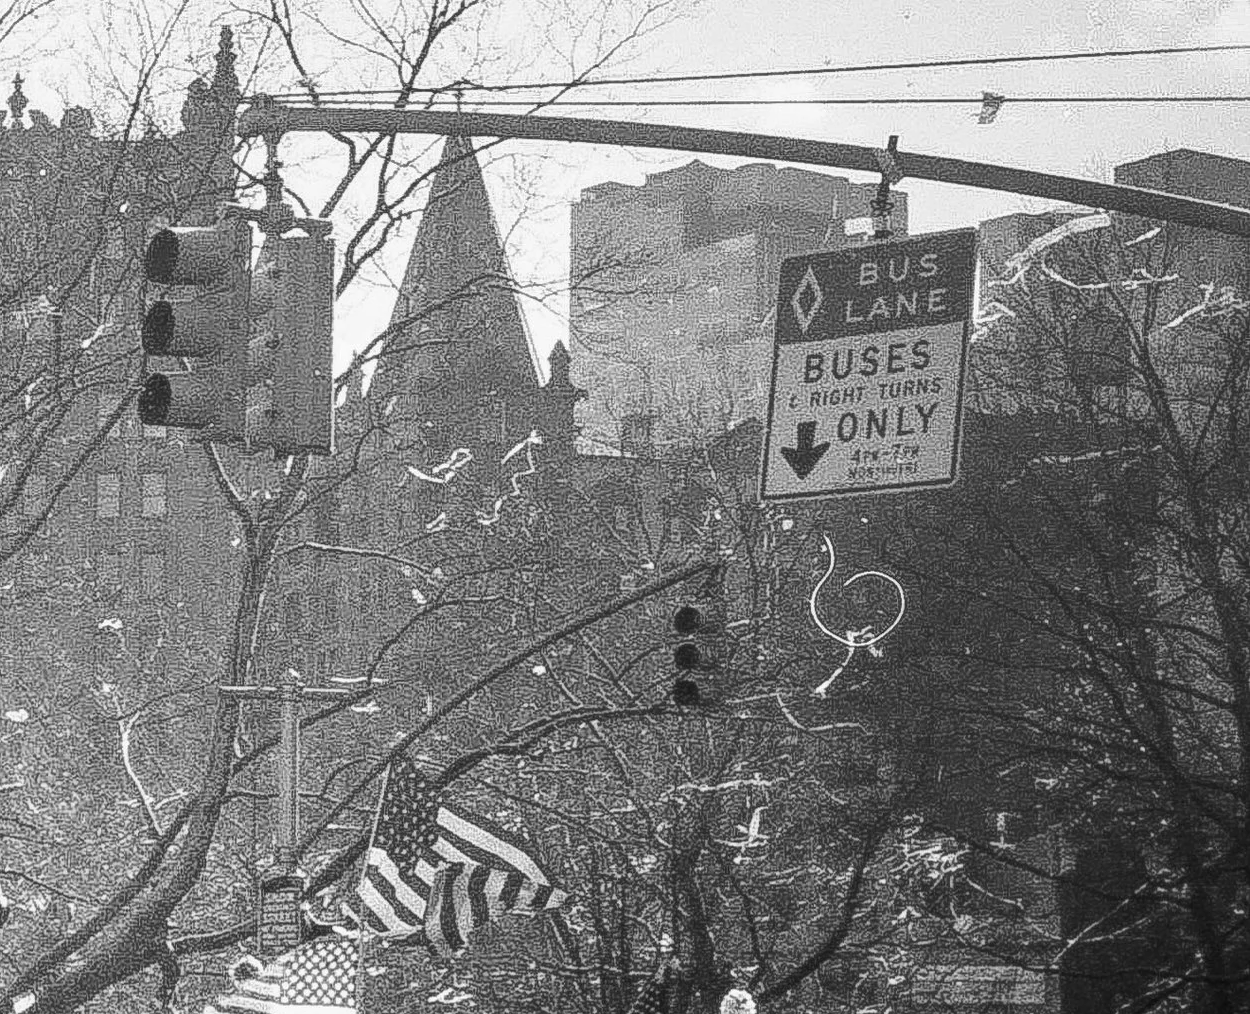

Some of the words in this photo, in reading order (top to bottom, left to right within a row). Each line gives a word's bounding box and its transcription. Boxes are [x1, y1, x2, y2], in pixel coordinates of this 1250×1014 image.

[860, 253, 938, 285] BUS
[846, 288, 948, 323] LANE
[803, 340, 931, 384] BUSES
[810, 386, 866, 407] RIGHT
[879, 377, 943, 400] TURNS
[836, 402, 939, 443] ONLY
